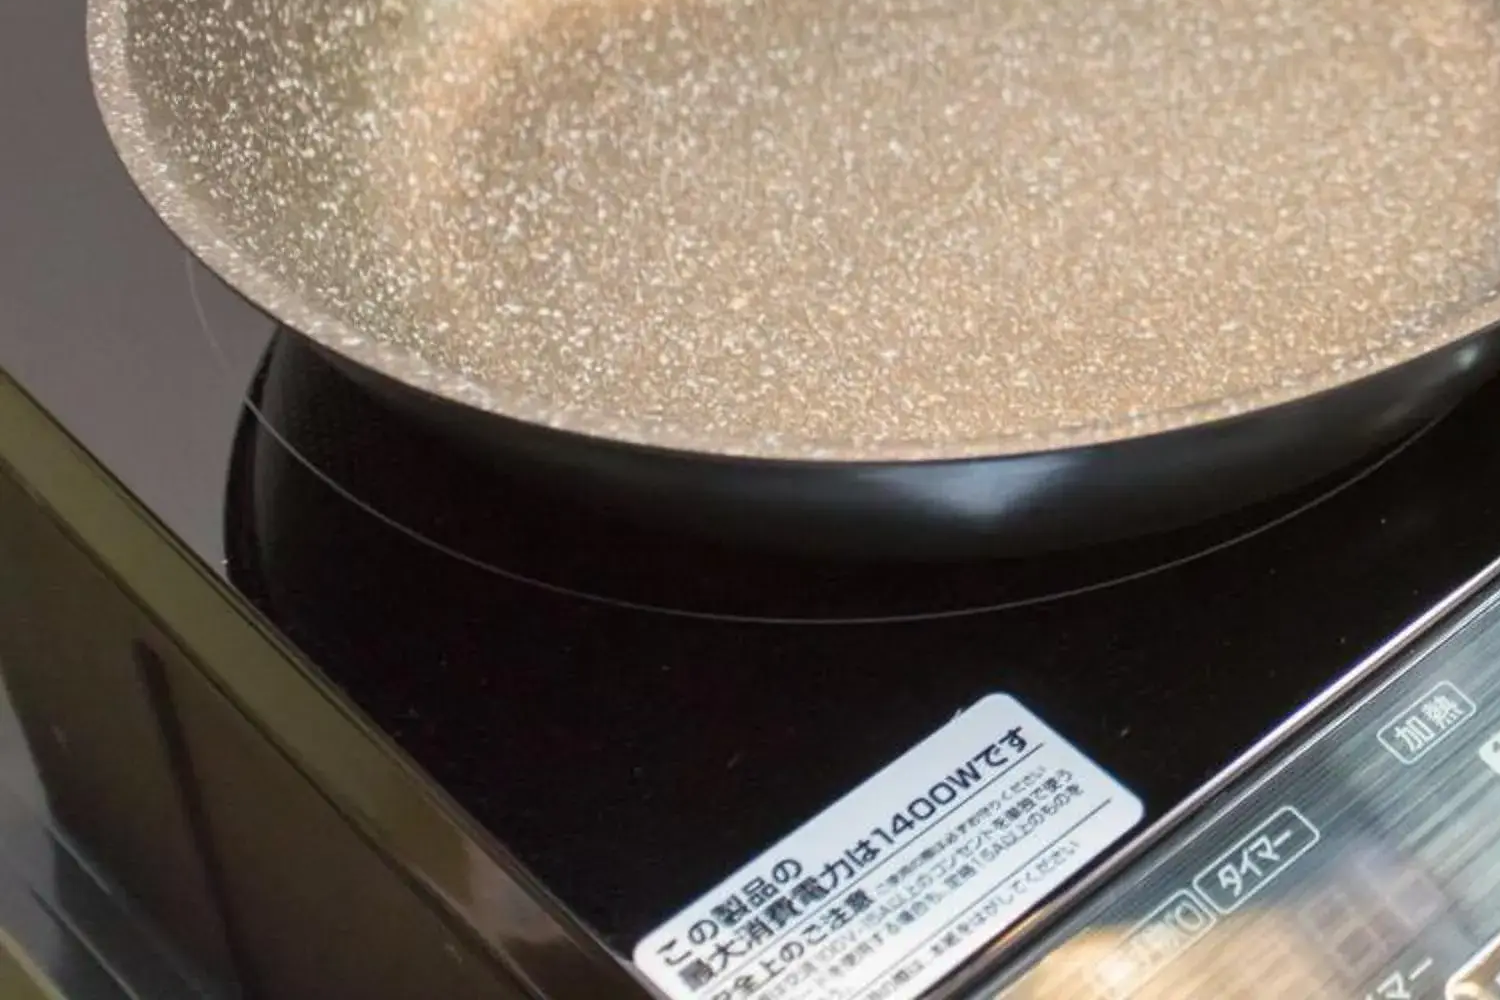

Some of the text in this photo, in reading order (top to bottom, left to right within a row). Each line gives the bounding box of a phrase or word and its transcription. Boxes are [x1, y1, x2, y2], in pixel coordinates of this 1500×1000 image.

[1394, 695, 1464, 752] 加熱
[678, 727, 1030, 993] 最大消費電力は1400Wです
[1217, 829, 1293, 899] タイマー
[656, 858, 804, 967] この製品の
